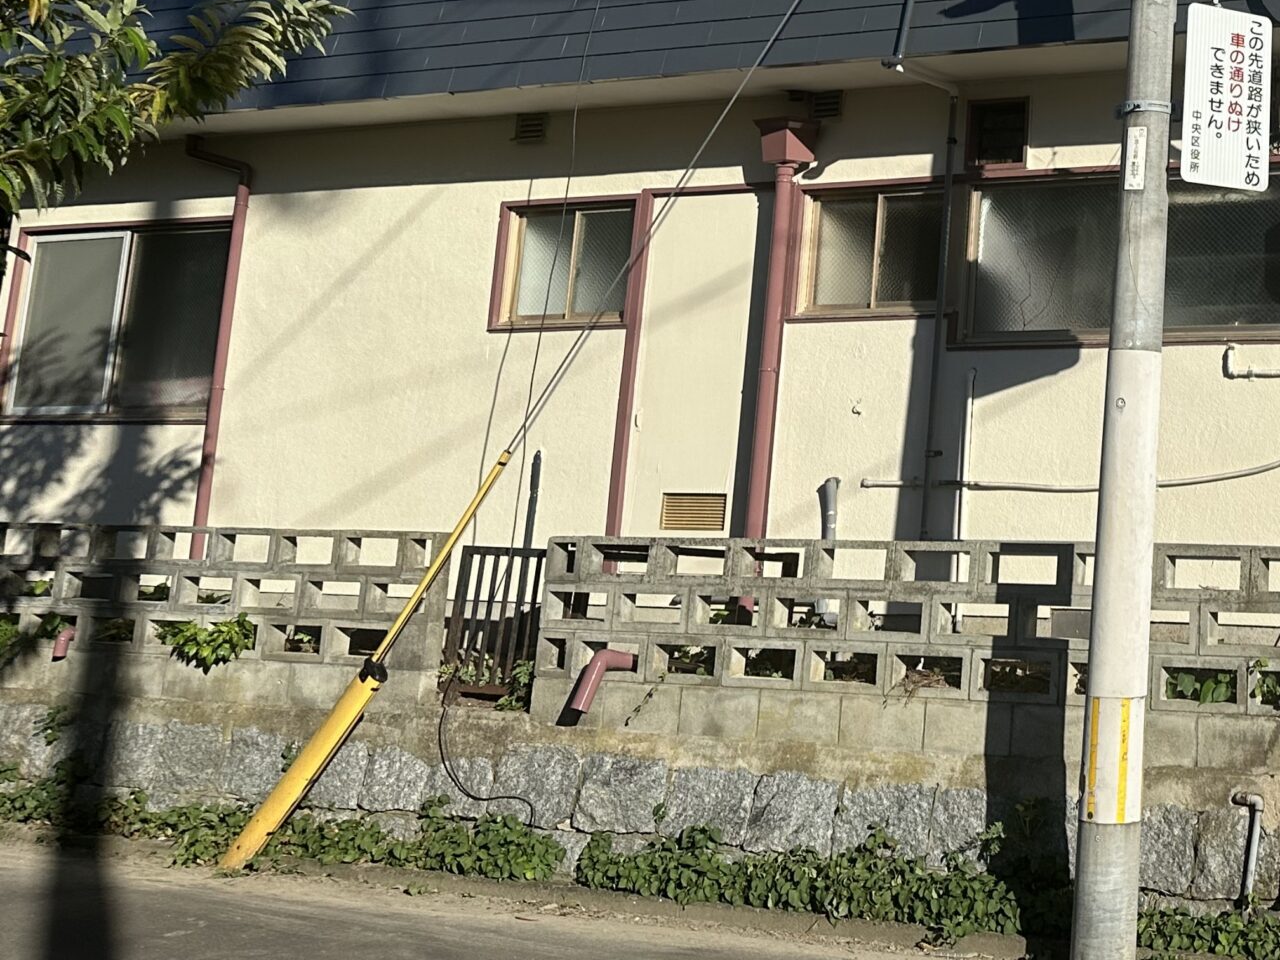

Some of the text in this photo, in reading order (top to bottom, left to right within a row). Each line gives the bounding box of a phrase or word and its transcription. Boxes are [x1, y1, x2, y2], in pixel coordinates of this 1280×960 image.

[1207, 46, 1225, 140] できません。
[1227, 32, 1245, 132] 車の通りぬけ
[1244, 20, 1264, 187] この先道路が狭いため
[1189, 110, 1202, 174] 中央区役所
